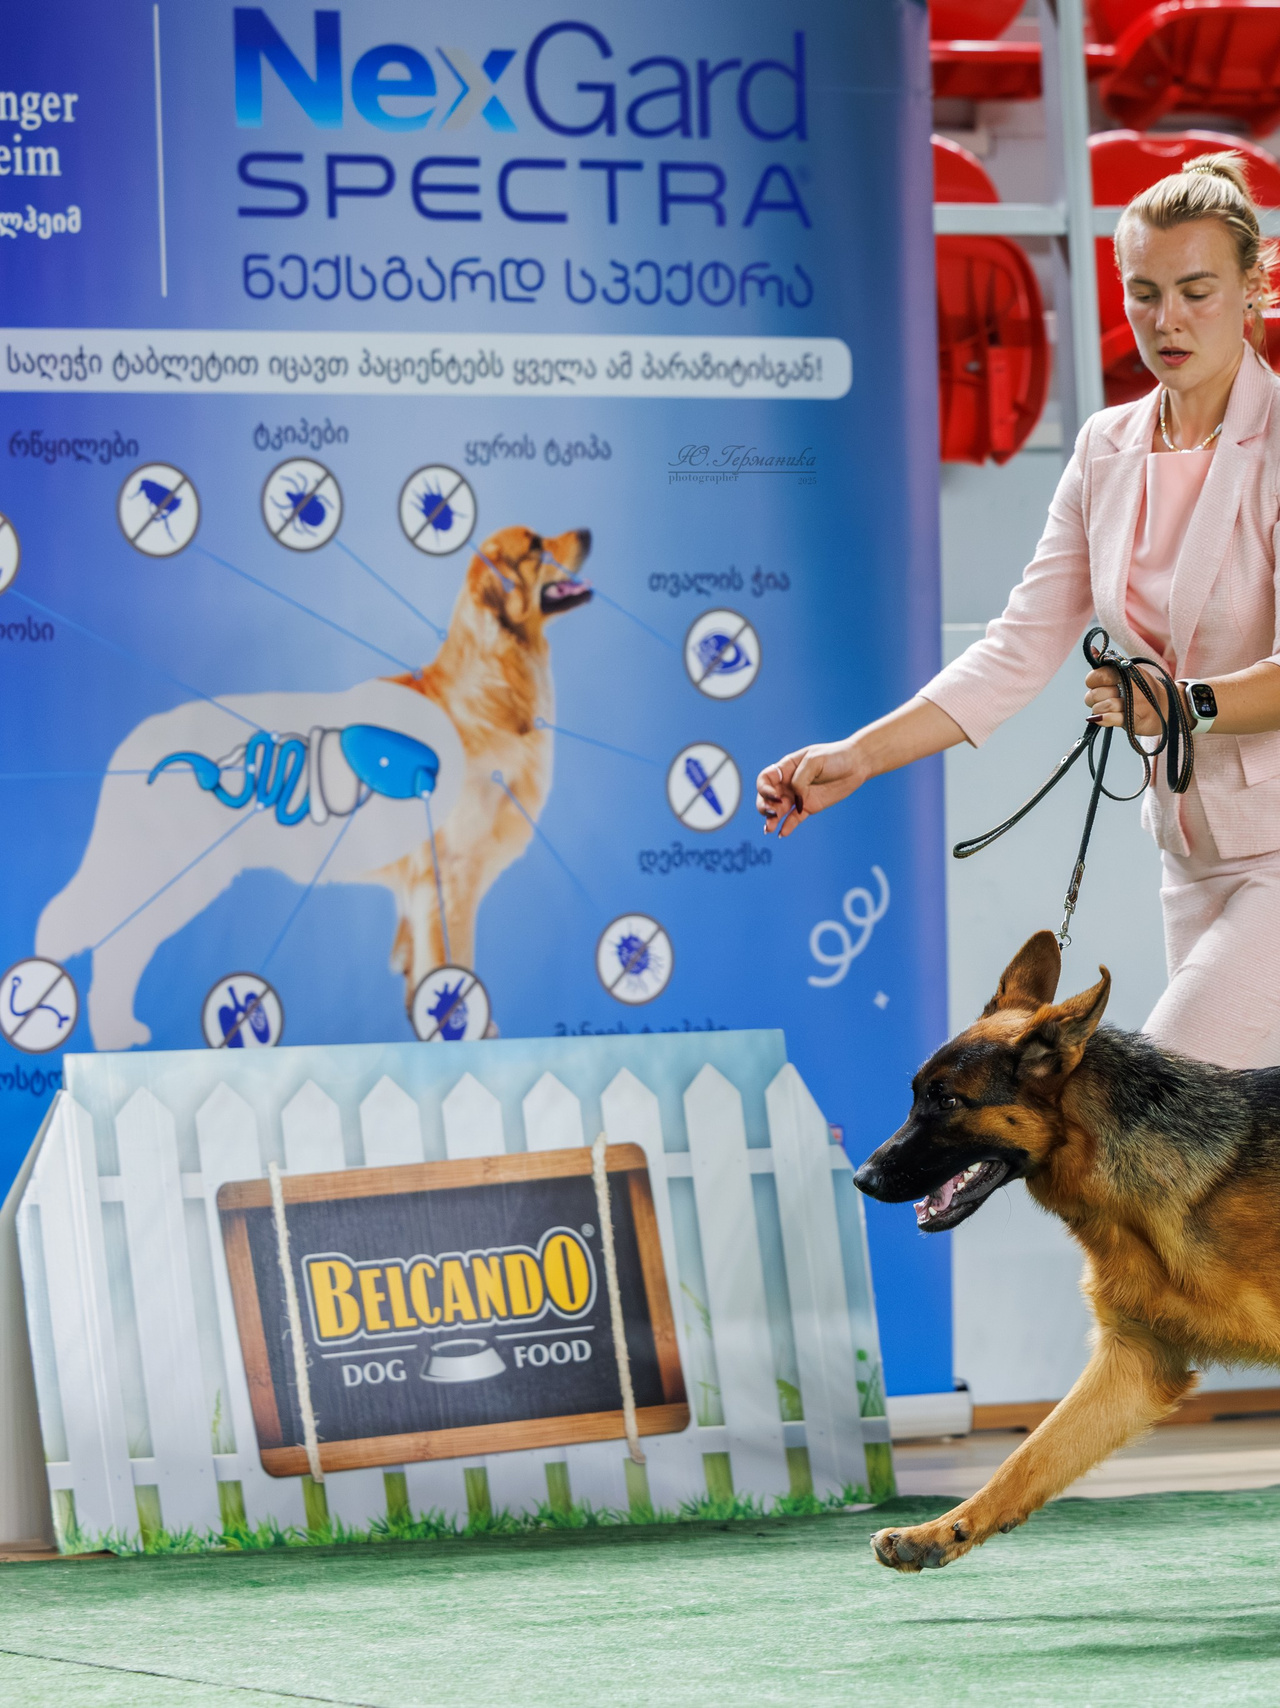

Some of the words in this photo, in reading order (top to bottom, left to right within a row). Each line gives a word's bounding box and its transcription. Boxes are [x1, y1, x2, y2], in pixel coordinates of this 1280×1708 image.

[233, 7, 809, 142] NexGard
[0, 91, 78, 131] nger
[237, 152, 812, 230] SPECTRA
[243, 254, 546, 303] ნექსგარდ
[565, 258, 814, 308] სპექტრა
[6, 344, 102, 382] საღეჭი
[112, 345, 259, 383] ტაბლეტით
[268, 355, 349, 384] იცავთ
[358, 347, 504, 385] პაციენტებს
[513, 357, 597, 385] ყველა
[606, 350, 632, 379] ამ
[641, 352, 823, 388] პარაზიტისგან!
[9, 429, 139, 465] რწყილები
[253, 417, 349, 451] ტკიპები
[341, 1358, 408, 1388] DOG
[513, 1338, 593, 1369] FOOD
